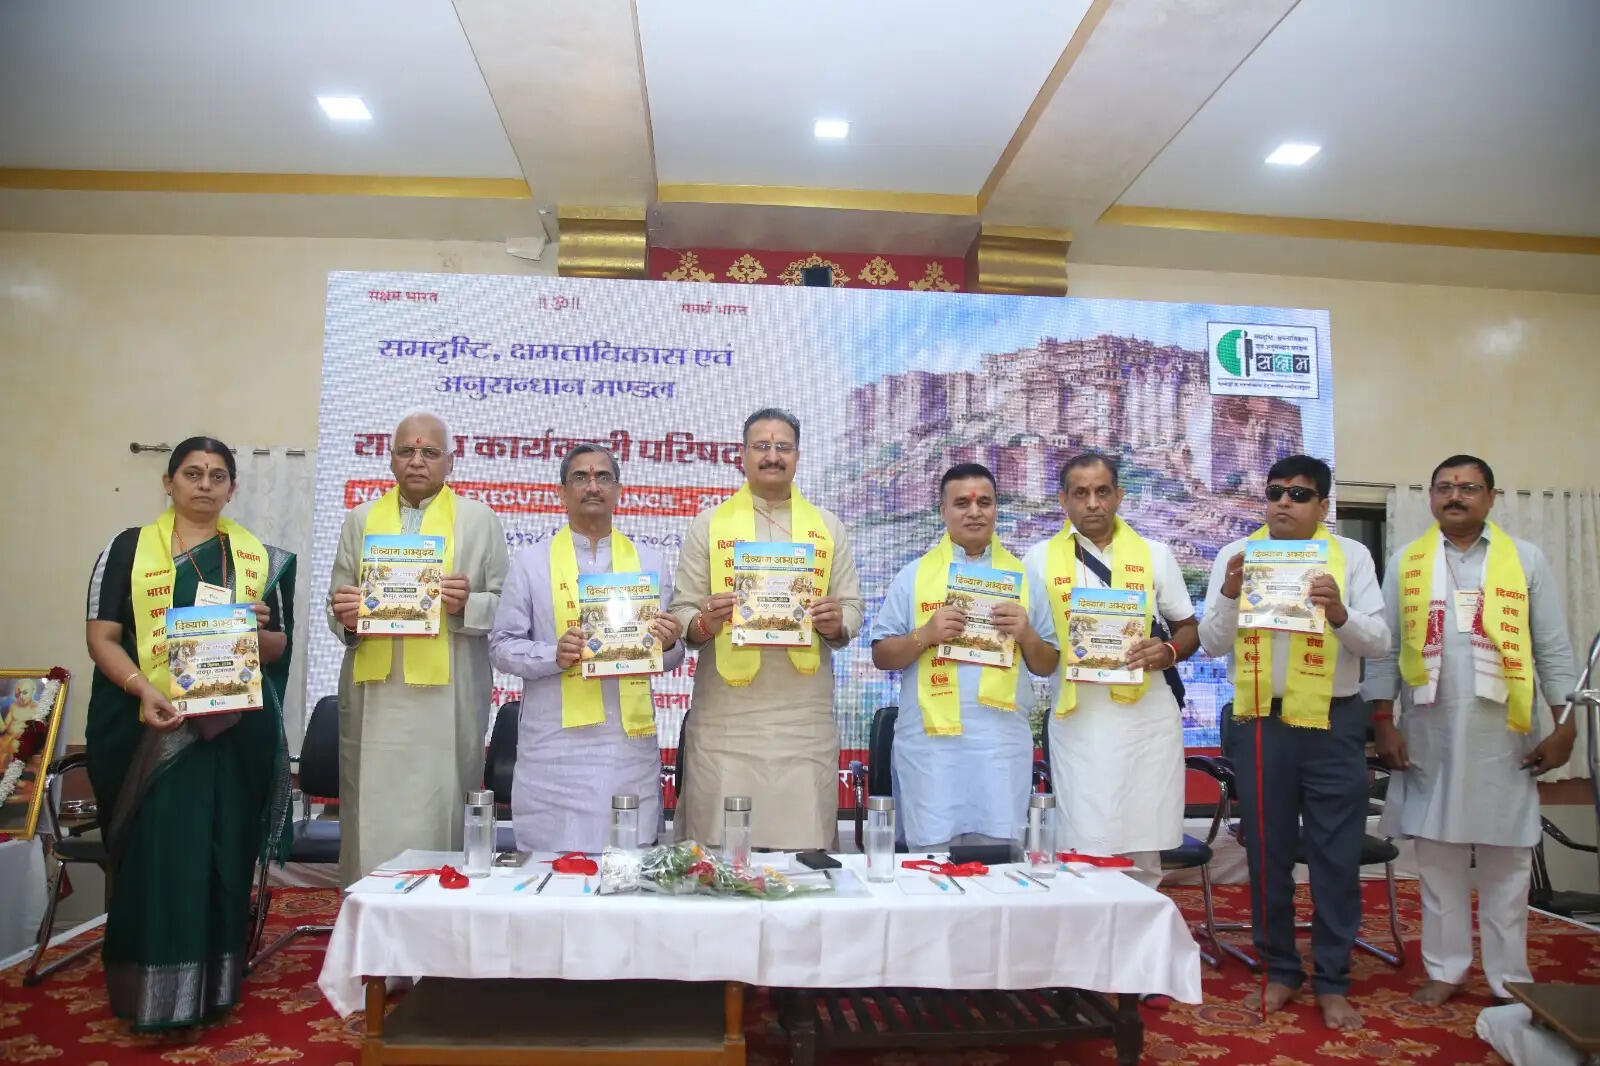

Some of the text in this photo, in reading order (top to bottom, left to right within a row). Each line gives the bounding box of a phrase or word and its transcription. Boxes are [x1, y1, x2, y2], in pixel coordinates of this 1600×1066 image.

[406, 292, 438, 304] भारत
[716, 305, 749, 316] भारत
[378, 336, 735, 367] समदृष्टि, क्षमताविकास एवं
[435, 376, 676, 400] अनुसन्धान मण्डल
[464, 486, 562, 506] EXECUTIV
[618, 493, 678, 509] UNCIL
